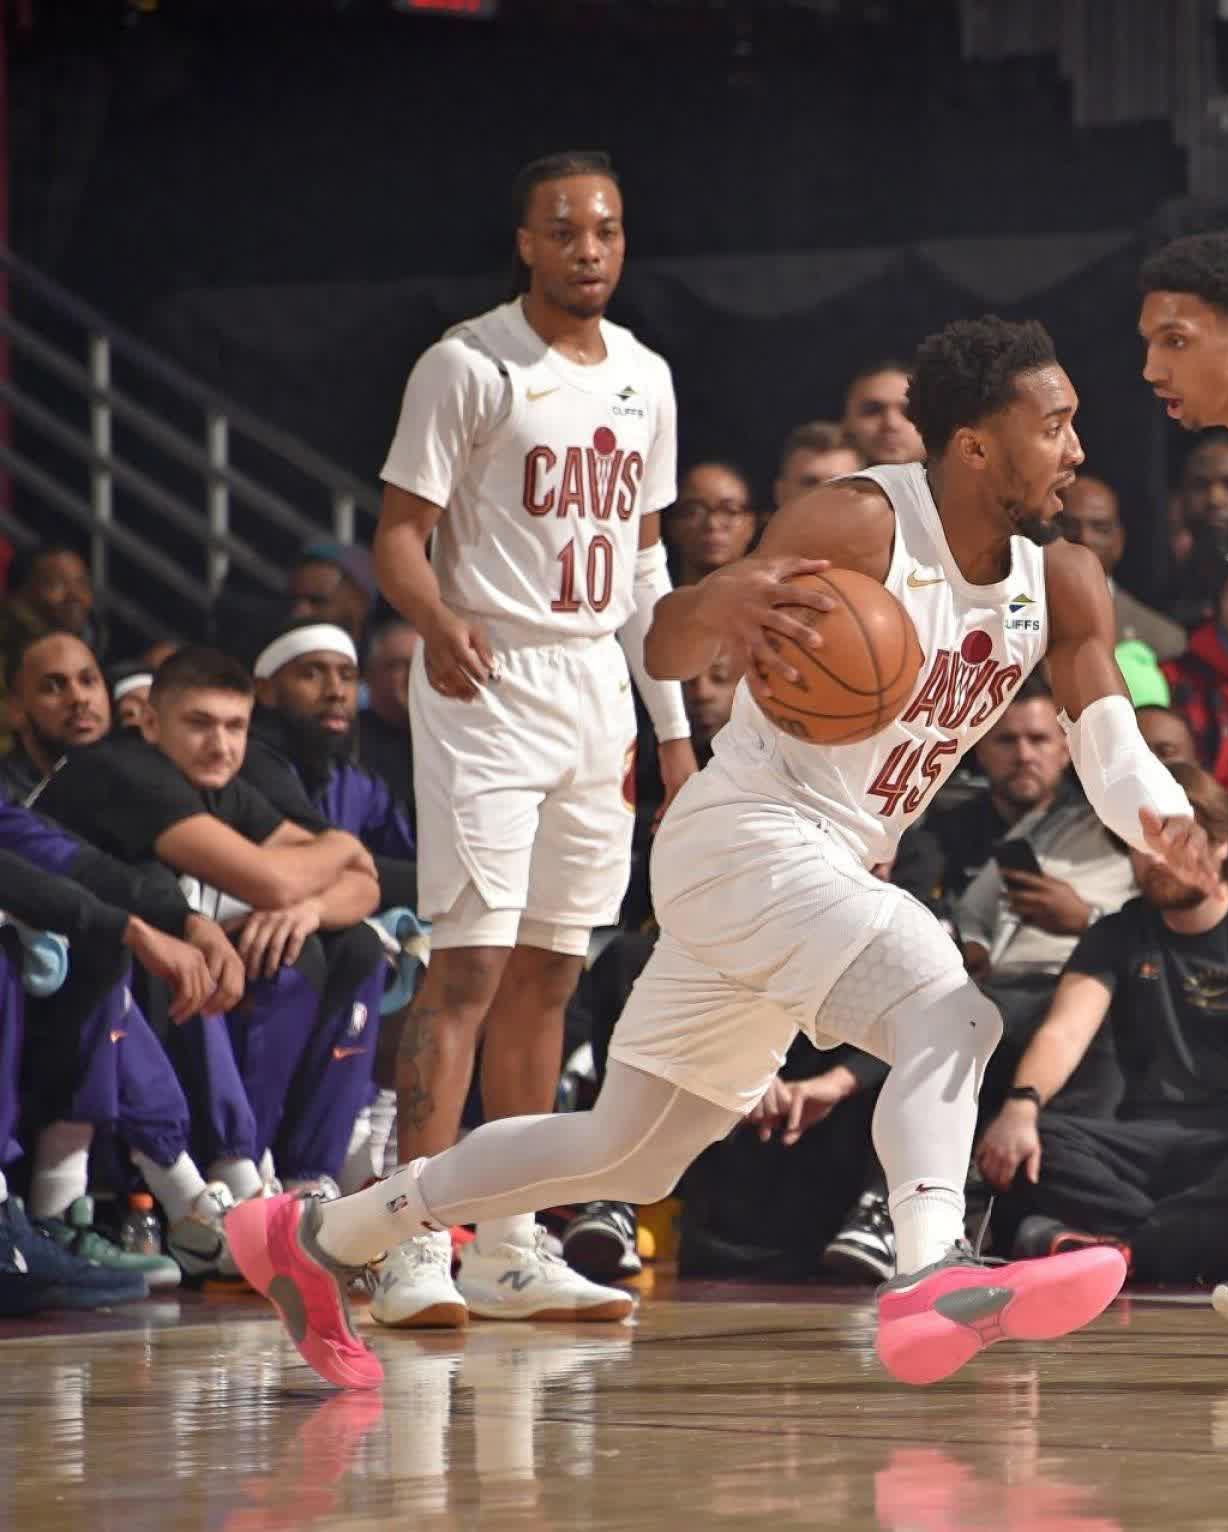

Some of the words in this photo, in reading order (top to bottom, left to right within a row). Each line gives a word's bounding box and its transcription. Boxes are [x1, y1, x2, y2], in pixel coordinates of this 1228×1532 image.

[522, 445, 644, 521] CAVS
[551, 535, 613, 613] 10
[1004, 619, 1040, 631] LIFFS
[900, 648, 1022, 730] AVS
[866, 738, 959, 817] 45
